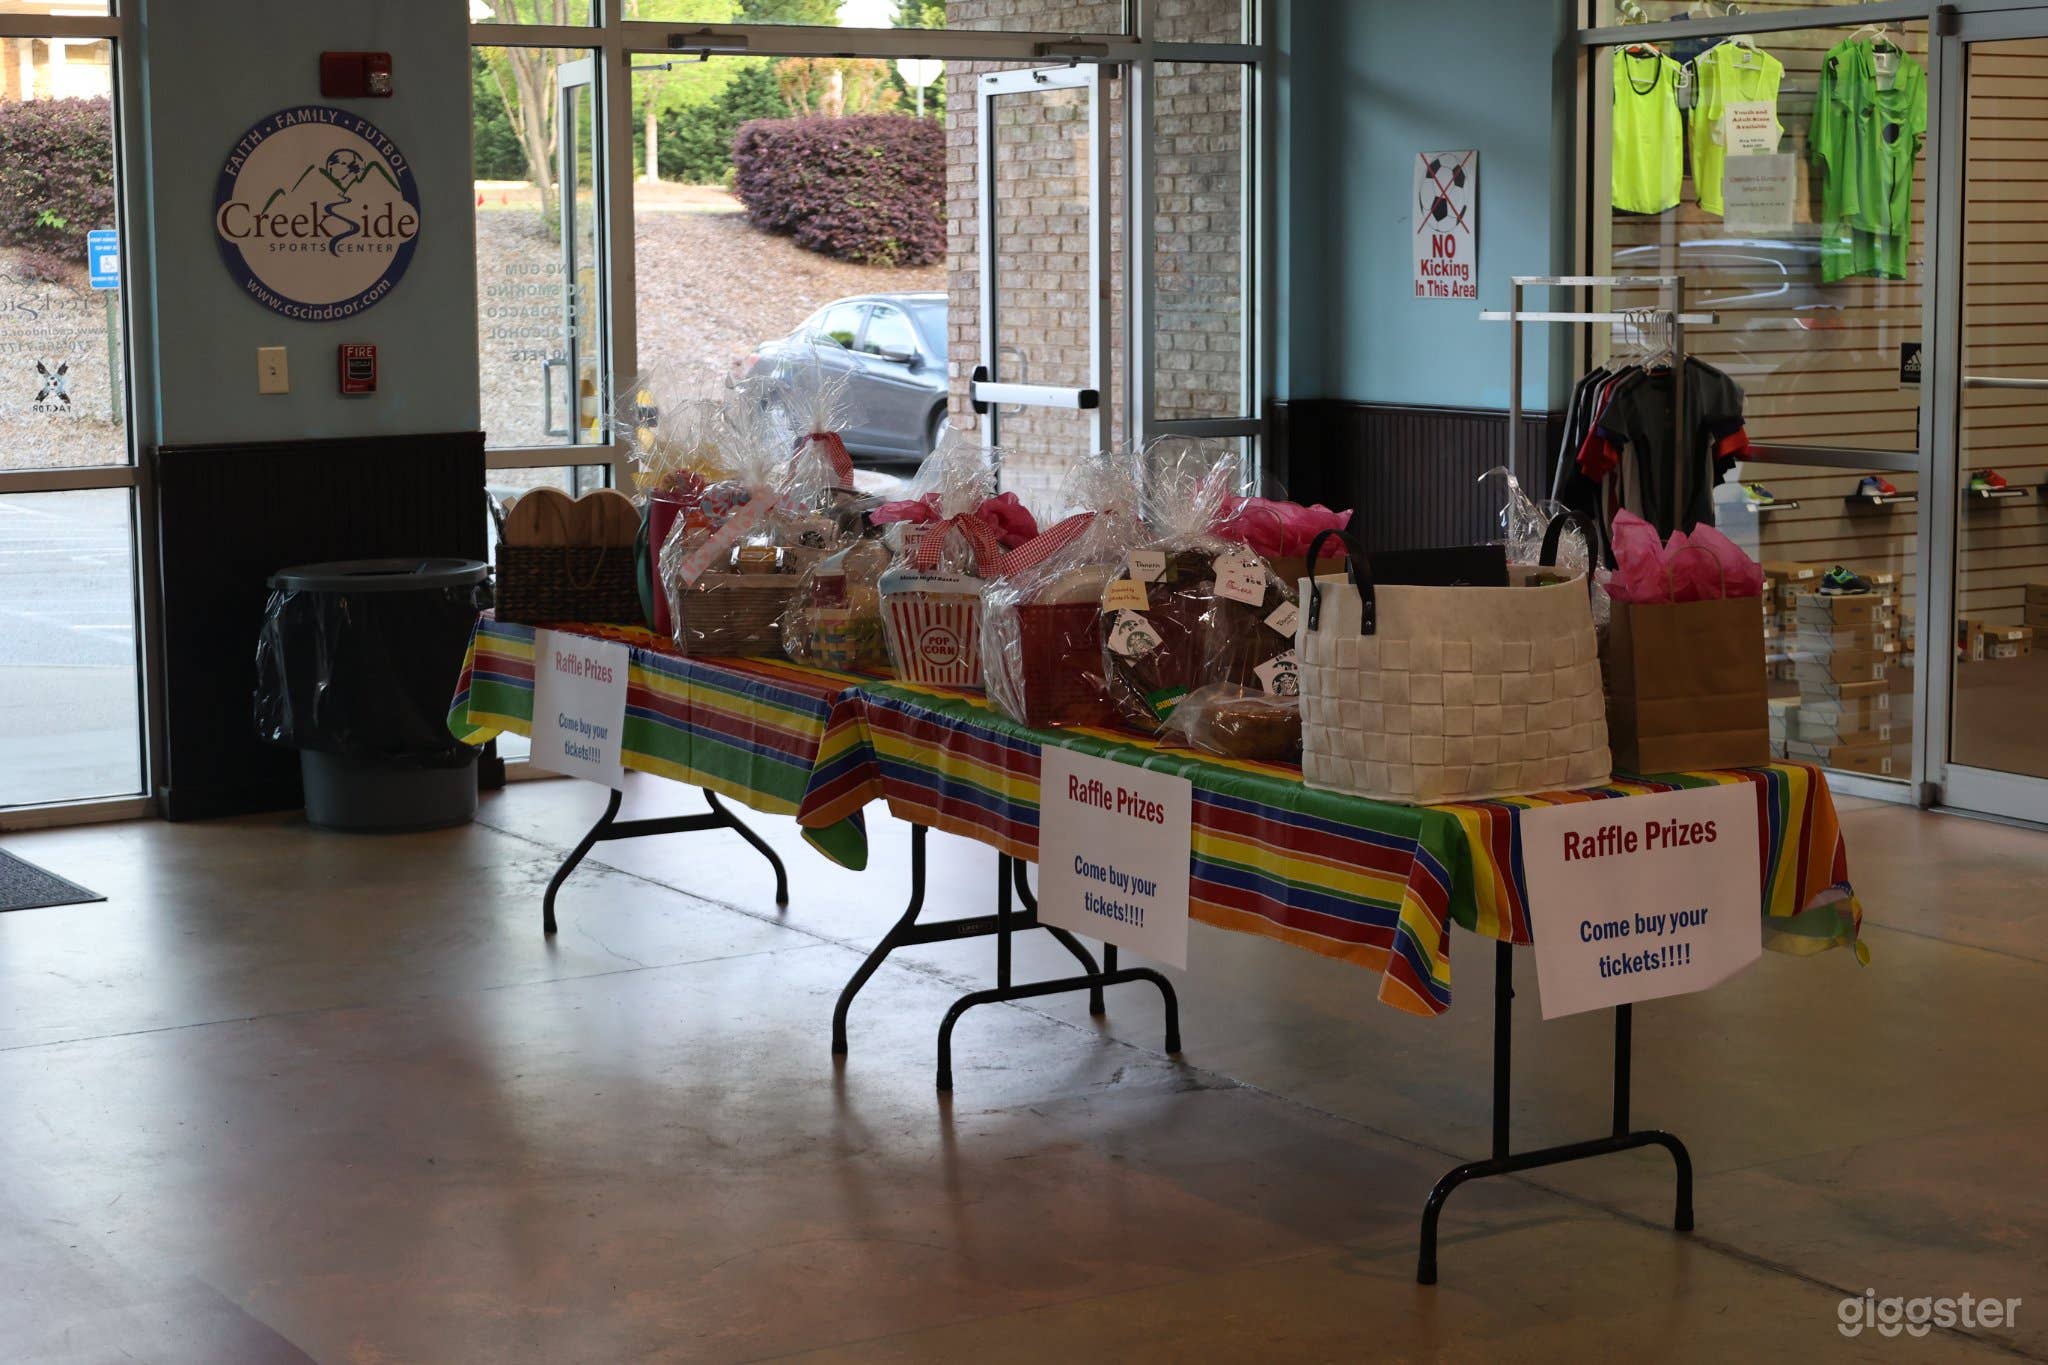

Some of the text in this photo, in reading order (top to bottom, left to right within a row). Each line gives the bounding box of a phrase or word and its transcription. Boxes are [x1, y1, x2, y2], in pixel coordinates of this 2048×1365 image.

[225, 110, 409, 176] FAITH FAMILY FUTBOL
[220, 197, 416, 250] CreekSide
[269, 242, 394, 253] SPORTS CENTER
[1432, 233, 1456, 259] NO
[1420, 259, 1469, 282] Kicking
[247, 278, 391, 321] www.cscindoor.com
[1415, 280, 1475, 298] In This Area
[347, 346, 374, 358] FIRE
[925, 645, 955, 656] CORN
[928, 636, 950, 645] POP
[556, 651, 613, 684] Raffle Prizes
[559, 712, 609, 741] Come buy your
[565, 739, 601, 764] tickets!!!!
[1069, 773, 1165, 825] Raffle Prizes
[1564, 818, 1718, 862] Raffle Prizes
[1074, 854, 1157, 898] Come buy your
[1084, 891, 1144, 929] tickets!!!!
[1579, 907, 1708, 943] Come buy your
[1599, 942, 1691, 978] tickets!!!!
